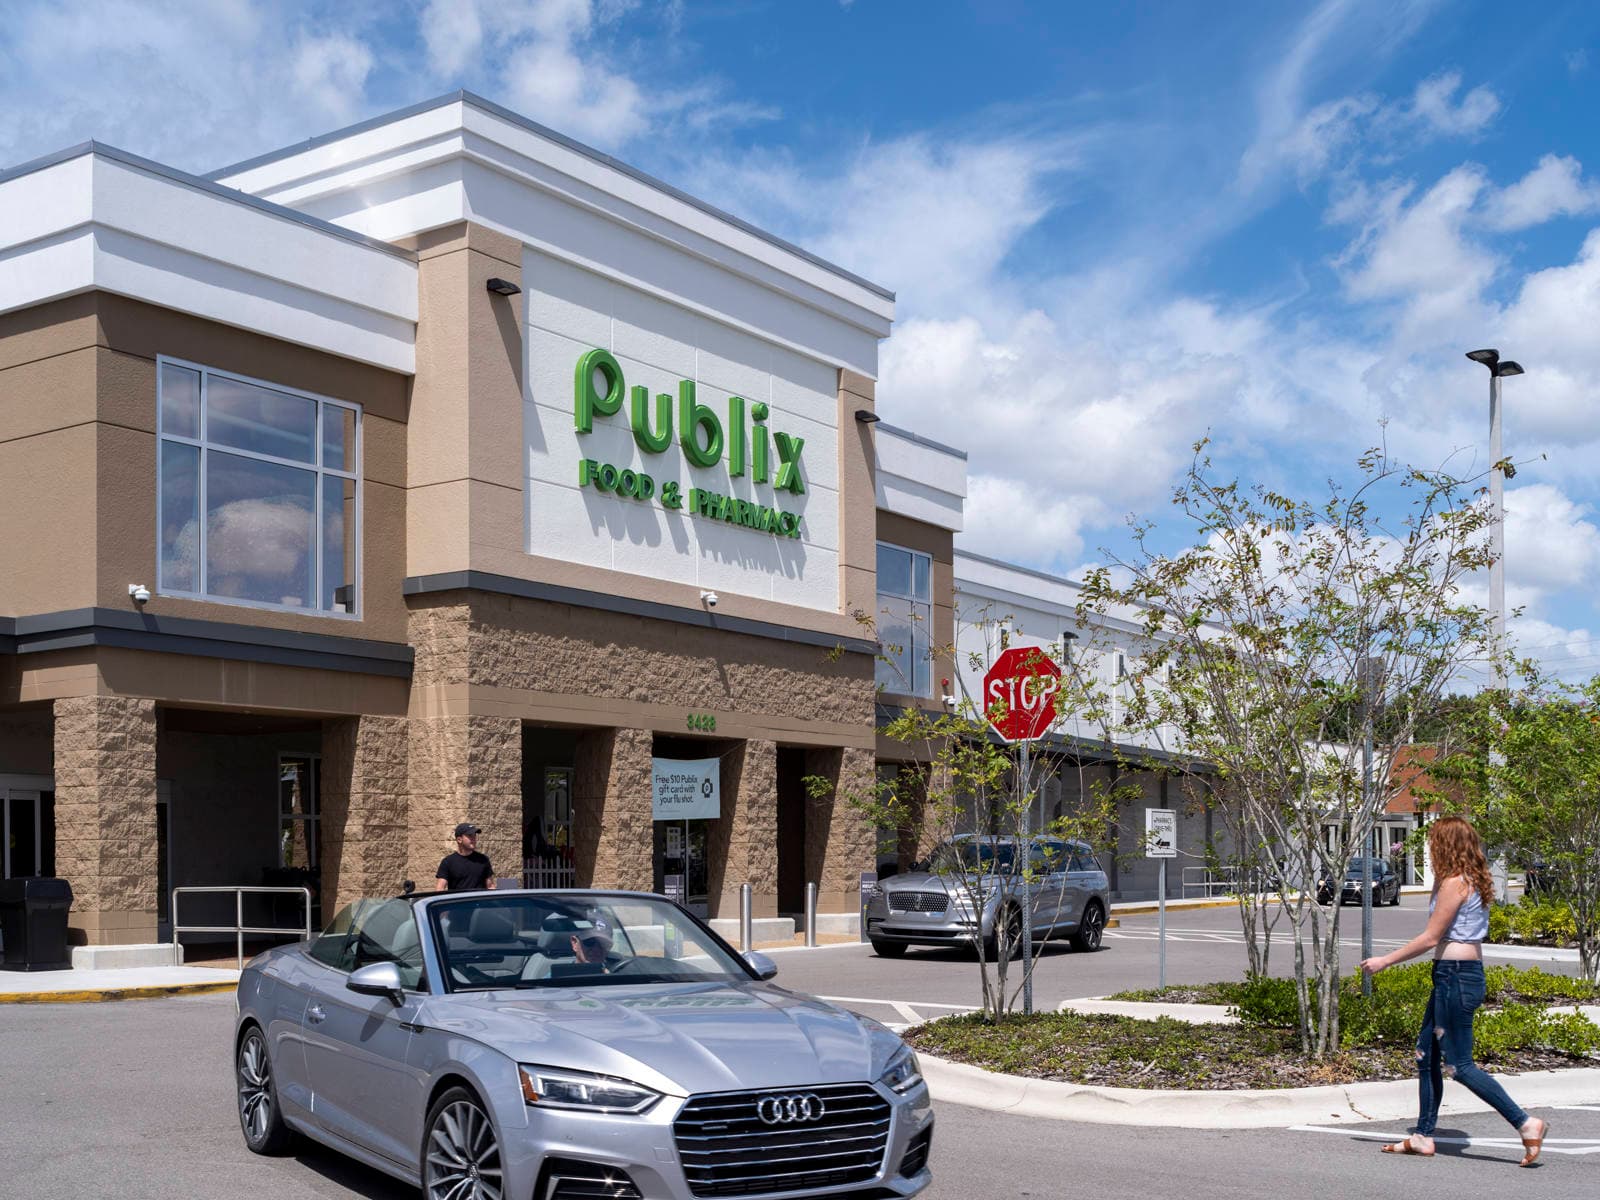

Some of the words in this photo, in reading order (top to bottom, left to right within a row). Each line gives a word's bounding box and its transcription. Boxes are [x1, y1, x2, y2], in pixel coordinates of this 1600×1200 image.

[574, 348, 805, 495] Publix
[578, 458, 655, 500] FOOD
[660, 481, 683, 509] &
[689, 488, 803, 539] PHARMACY
[989, 674, 1057, 711] STOP
[656, 775, 670, 783] Free
[670, 774, 681, 784] $10
[681, 774, 697, 783] Publix
[658, 784, 670, 795] gift
[671, 784, 684, 793] card
[684, 784, 696, 793] with
[659, 796, 673, 805] your
[673, 794, 681, 803] flu
